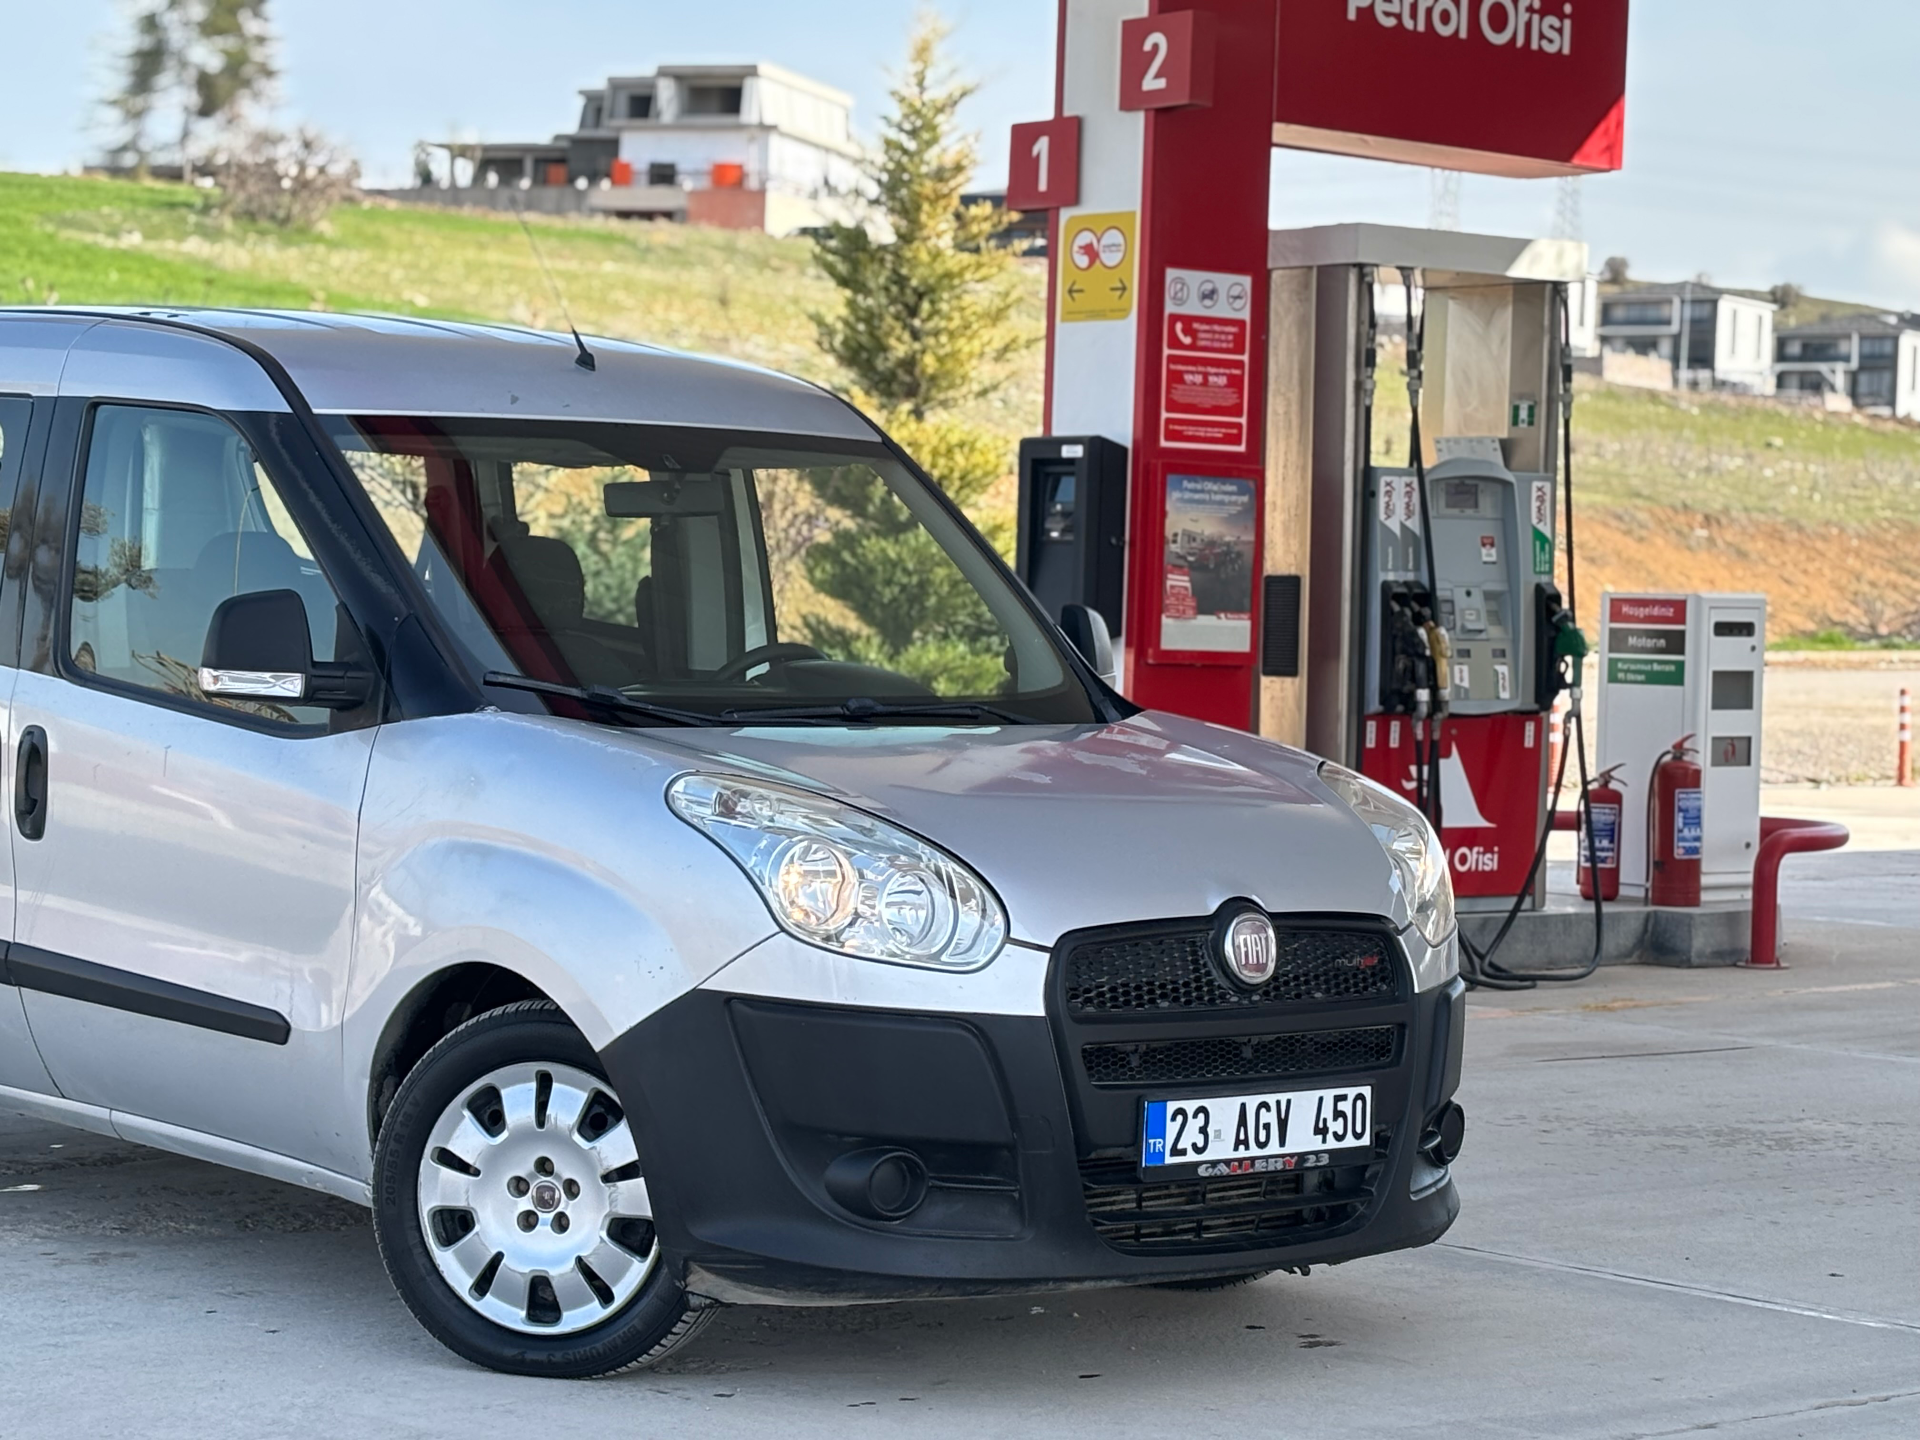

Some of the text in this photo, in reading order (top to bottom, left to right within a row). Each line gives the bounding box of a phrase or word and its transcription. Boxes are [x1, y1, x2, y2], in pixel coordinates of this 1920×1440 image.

[1479, 0, 1572, 55] Ofisi
[1142, 31, 1168, 92] 2
[1032, 135, 1049, 192] 1
[1454, 845, 1499, 872] Ofisi
[1240, 933, 1267, 966] FIAT
[1148, 1138, 1164, 1154] TR
[1169, 1092, 1368, 1158] 23 AGV 450
[385, 1148, 400, 1207] 205/55
[1197, 1153, 1330, 1177] GALLERY 23
[560, 1324, 640, 1363] BRAVURIS
